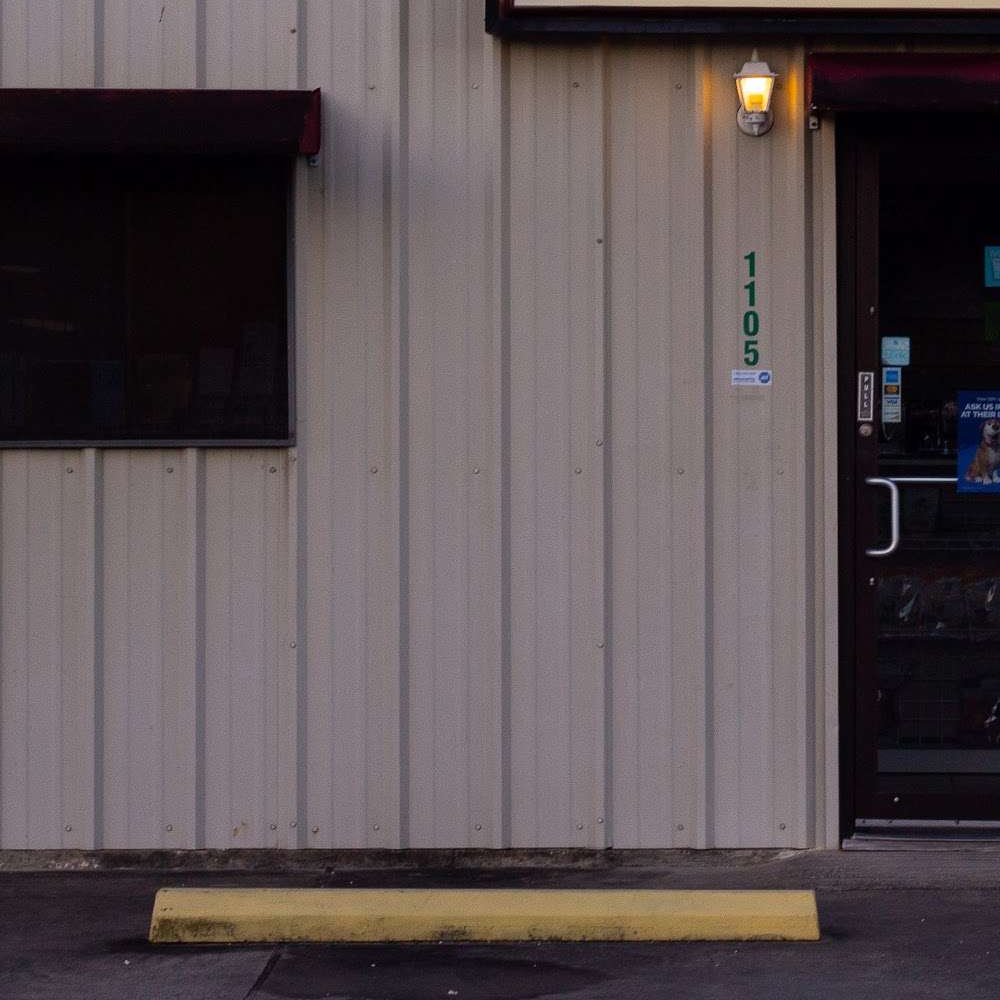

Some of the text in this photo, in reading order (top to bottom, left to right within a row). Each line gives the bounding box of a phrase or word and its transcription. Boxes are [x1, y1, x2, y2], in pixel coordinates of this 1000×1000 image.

[743, 251, 760, 367] 1105
[964, 403, 982, 411] ASK
[982, 403, 994, 411] US
